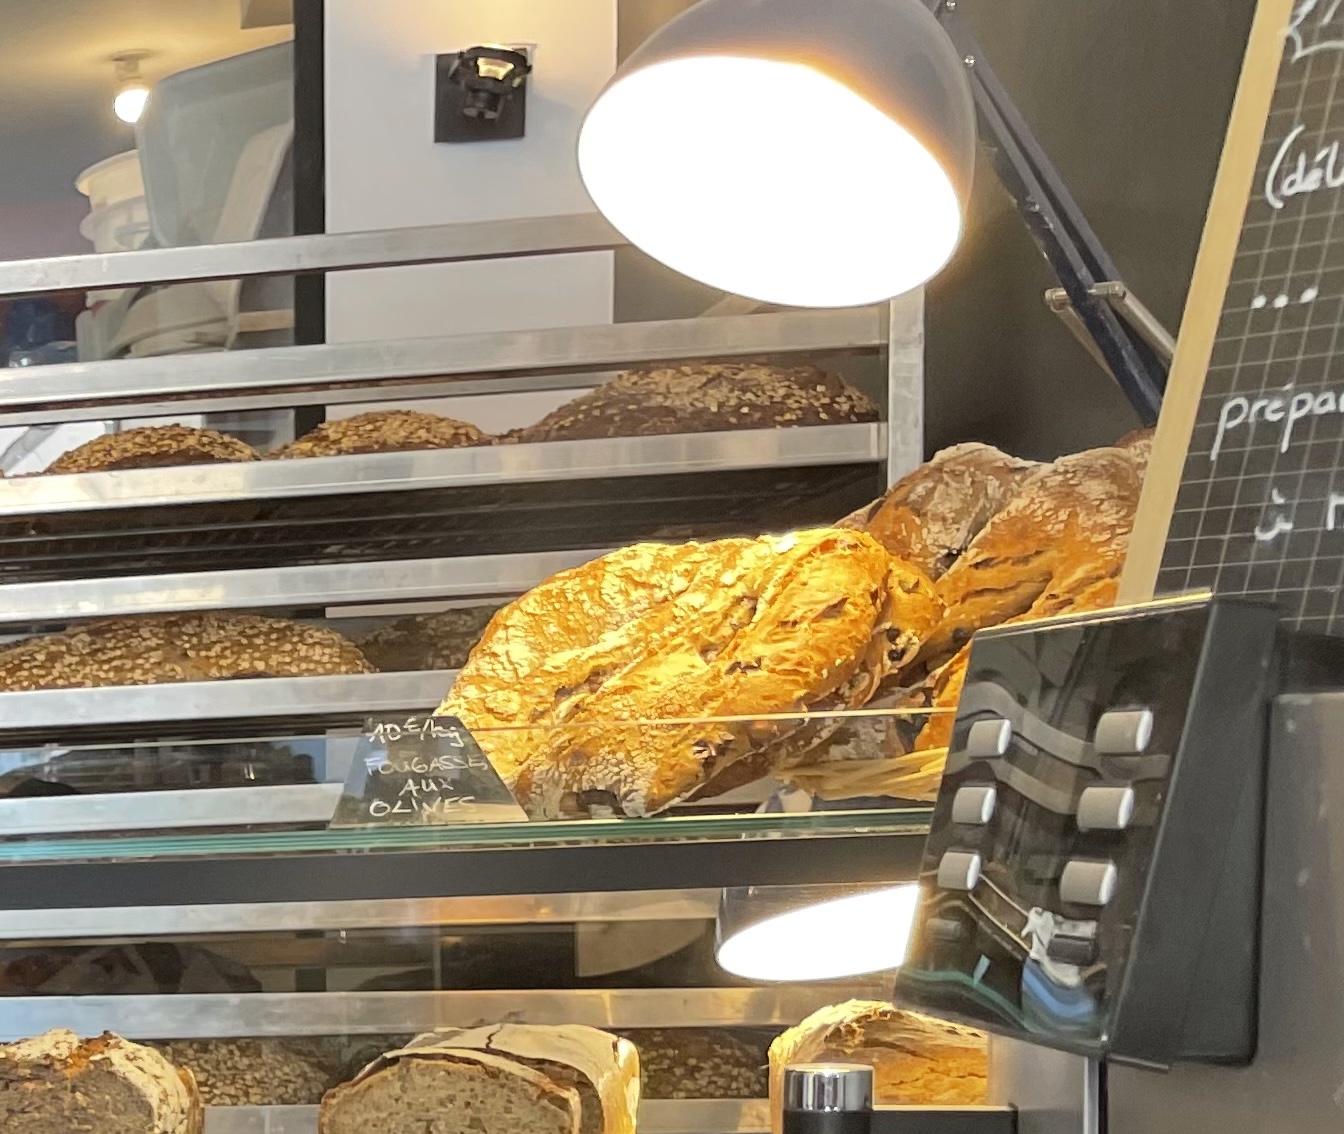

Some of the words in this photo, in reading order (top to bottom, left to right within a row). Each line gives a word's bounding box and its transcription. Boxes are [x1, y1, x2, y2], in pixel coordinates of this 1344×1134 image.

[1210, 382, 1344, 461] prépa
[365, 716, 465, 748] 10€/kg
[364, 754, 488, 777] FOUGASSE
[399, 779, 454, 797] AUX
[369, 796, 476, 821] OLIVES
